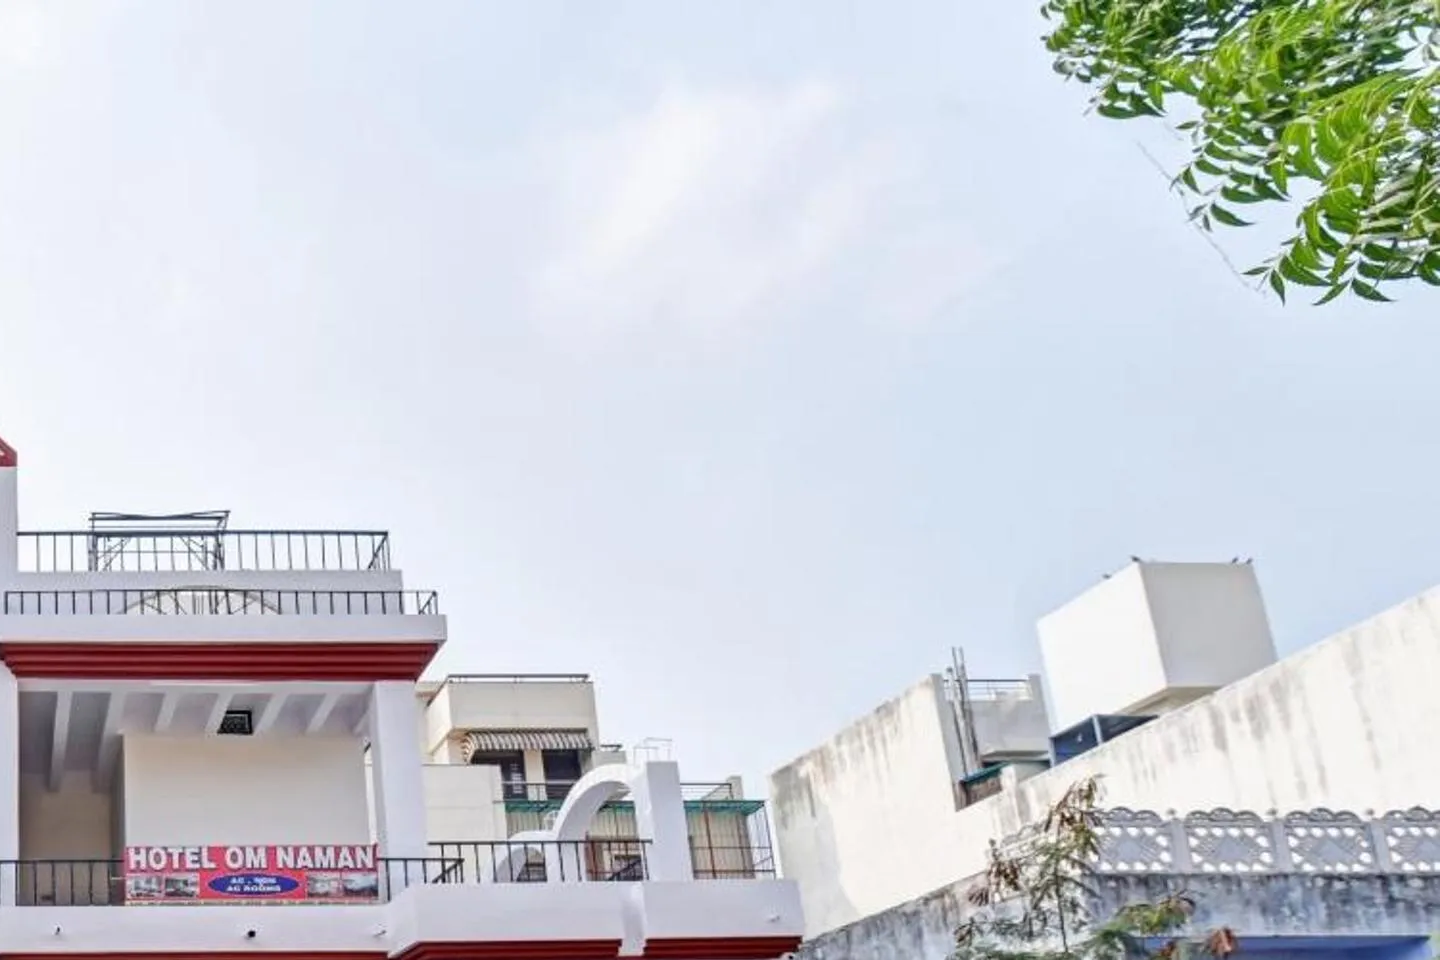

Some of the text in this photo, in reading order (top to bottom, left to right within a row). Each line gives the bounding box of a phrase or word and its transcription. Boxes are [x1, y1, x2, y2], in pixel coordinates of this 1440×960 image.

[128, 846, 374, 870] HOTEL OM NAMAN
